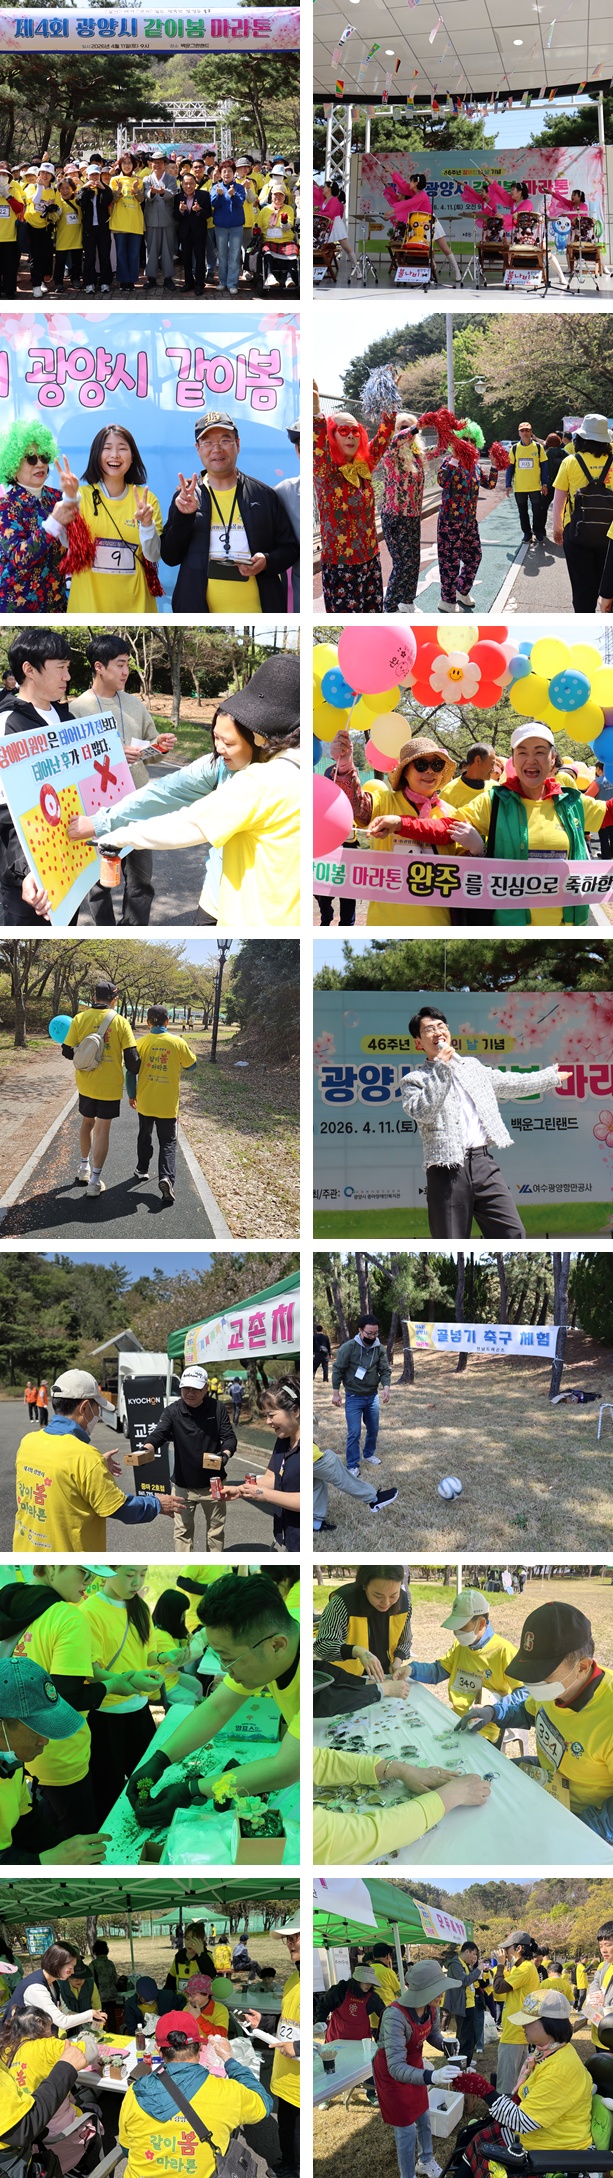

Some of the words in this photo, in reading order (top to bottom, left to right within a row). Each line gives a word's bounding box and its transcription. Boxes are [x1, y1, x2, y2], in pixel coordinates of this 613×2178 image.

[14, 17, 69, 38] 제4회
[75, 17, 138, 38] 광양시
[143, 18, 206, 38] 같이봄
[210, 18, 272, 38] 마라톤
[25, 346, 149, 408] 광양시
[166, 347, 284, 411] 같이봄
[111, 550, 121, 567] 9
[58, 721, 95, 746] 태어나기
[94, 716, 117, 734] 전보다
[31, 755, 61, 781] 태어난
[60, 748, 80, 769] 후가
[81, 743, 92, 761] 더
[91, 737, 111, 757] 많다.
[313, 861, 346, 886] 이봄
[352, 865, 402, 891] 마라톤
[408, 862, 460, 896] 완주
[490, 875, 559, 898] 진심으로
[367, 1038, 411, 1051] 46주년
[466, 1038, 478, 1051] 날
[482, 1038, 505, 1051] 기념
[320, 1121, 358, 1134] 2026.
[362, 1121, 376, 1134] 4.
[378, 1119, 418, 1134] 11.(토)
[511, 1117, 579, 1131] 백운그린랜드
[532, 1183, 593, 1193] 여수광양항만공사
[227, 1301, 295, 1351] 교촌치
[437, 1328, 477, 1344] 골넣기
[483, 1330, 512, 1345] 축구
[519, 1331, 550, 1347] 체험
[127, 1396, 161, 1406] KYOCHON
[20, 1501, 48, 1523] 마라톤
[459, 1676, 476, 1689] 340
[539, 1722, 558, 1756] 334
[150, 2131, 199, 2156] 같이봄
[155, 2155, 198, 2175] 마라톤
